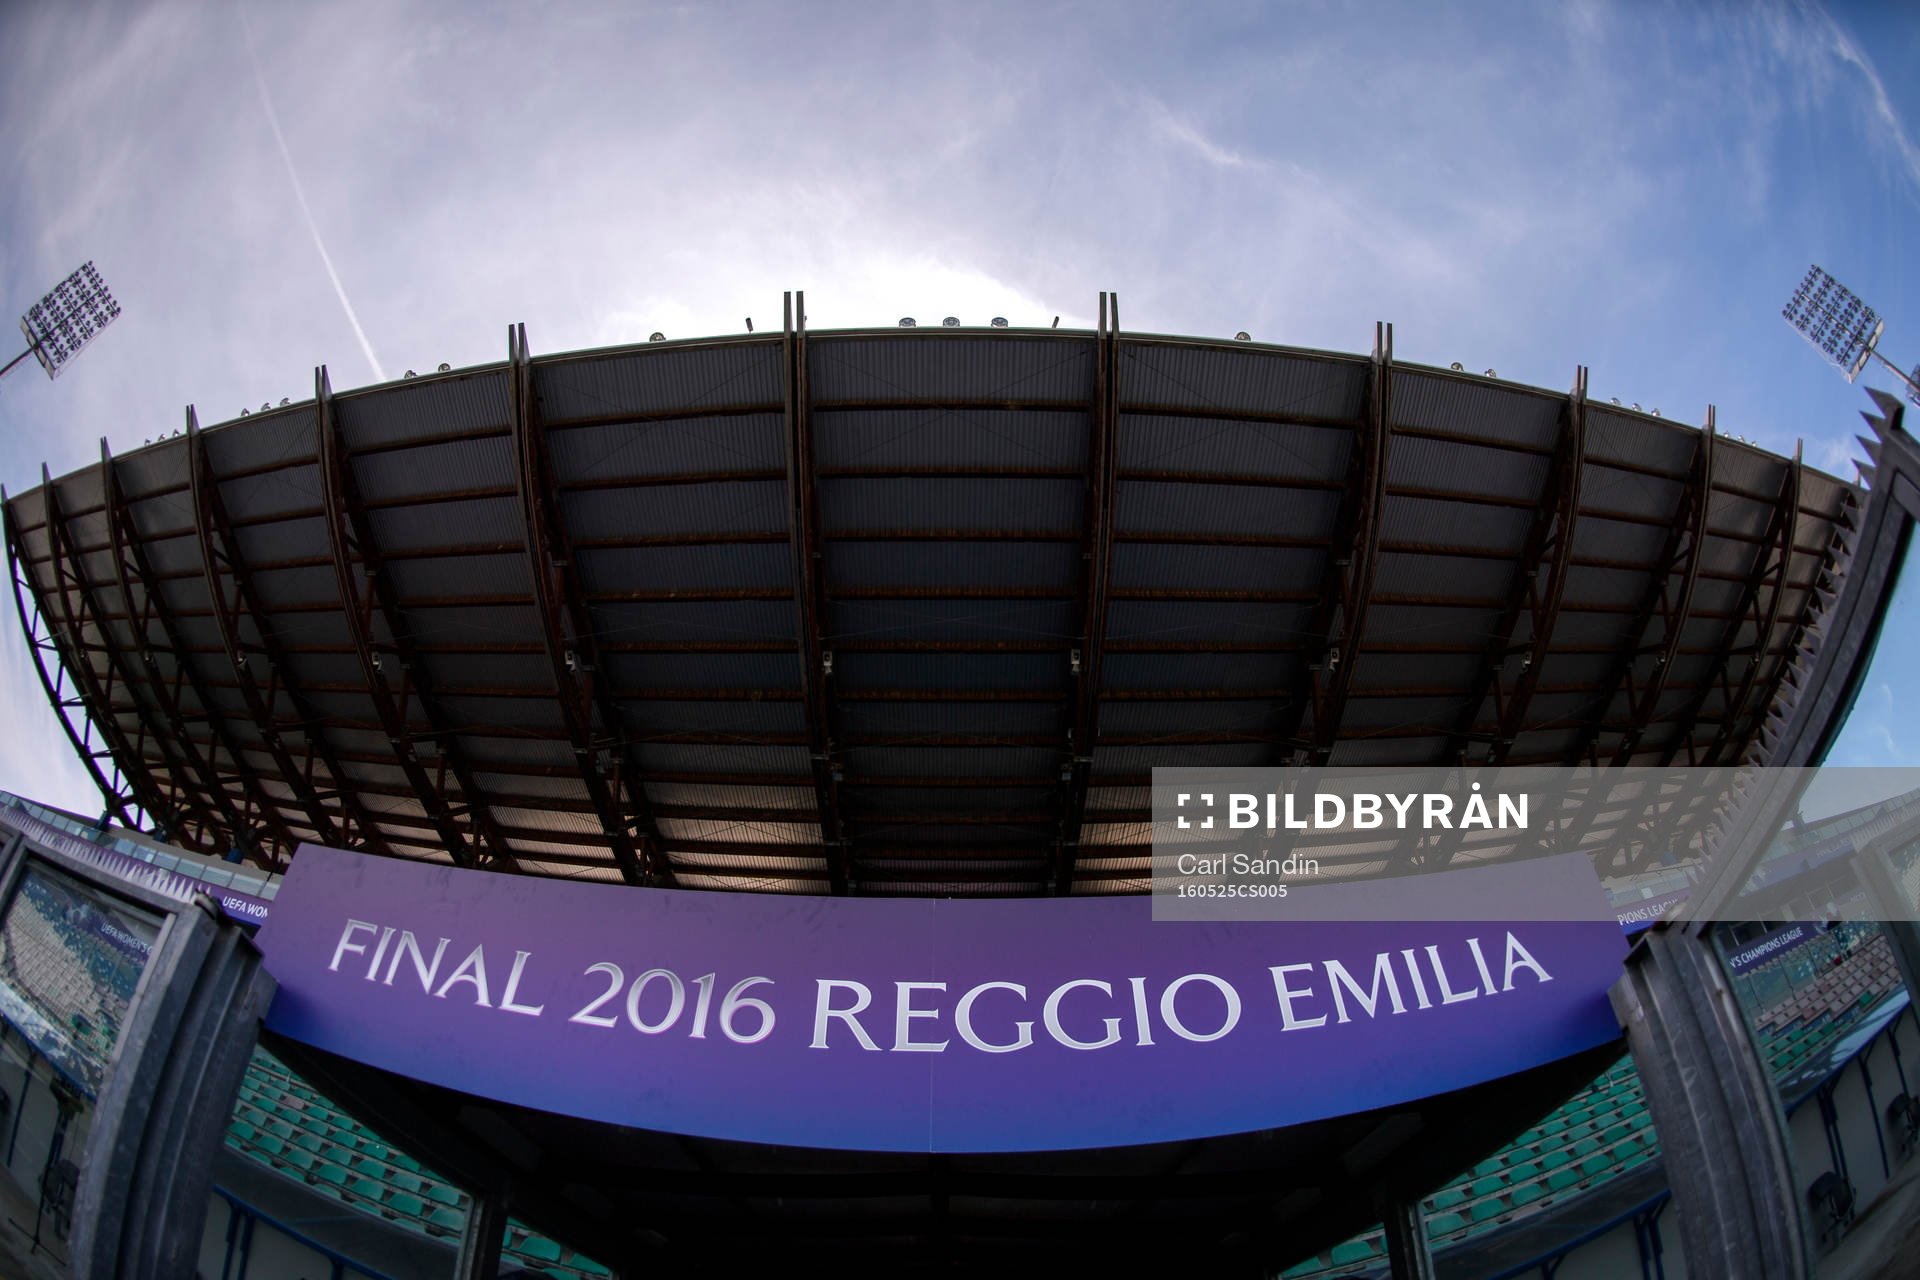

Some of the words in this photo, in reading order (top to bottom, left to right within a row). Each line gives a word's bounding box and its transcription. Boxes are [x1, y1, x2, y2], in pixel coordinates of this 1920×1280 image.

[222, 896, 247, 912] UEFA
[1646, 898, 1679, 917] LEA
[1740, 938, 1782, 964] CHAMPIONS
[1779, 926, 1804, 947] LEAGUE
[328, 918, 545, 1016] FINAL
[568, 961, 776, 1043] 2016
[808, 973, 1242, 1053] REGGIO
[1268, 931, 1553, 1032] EMILIA
